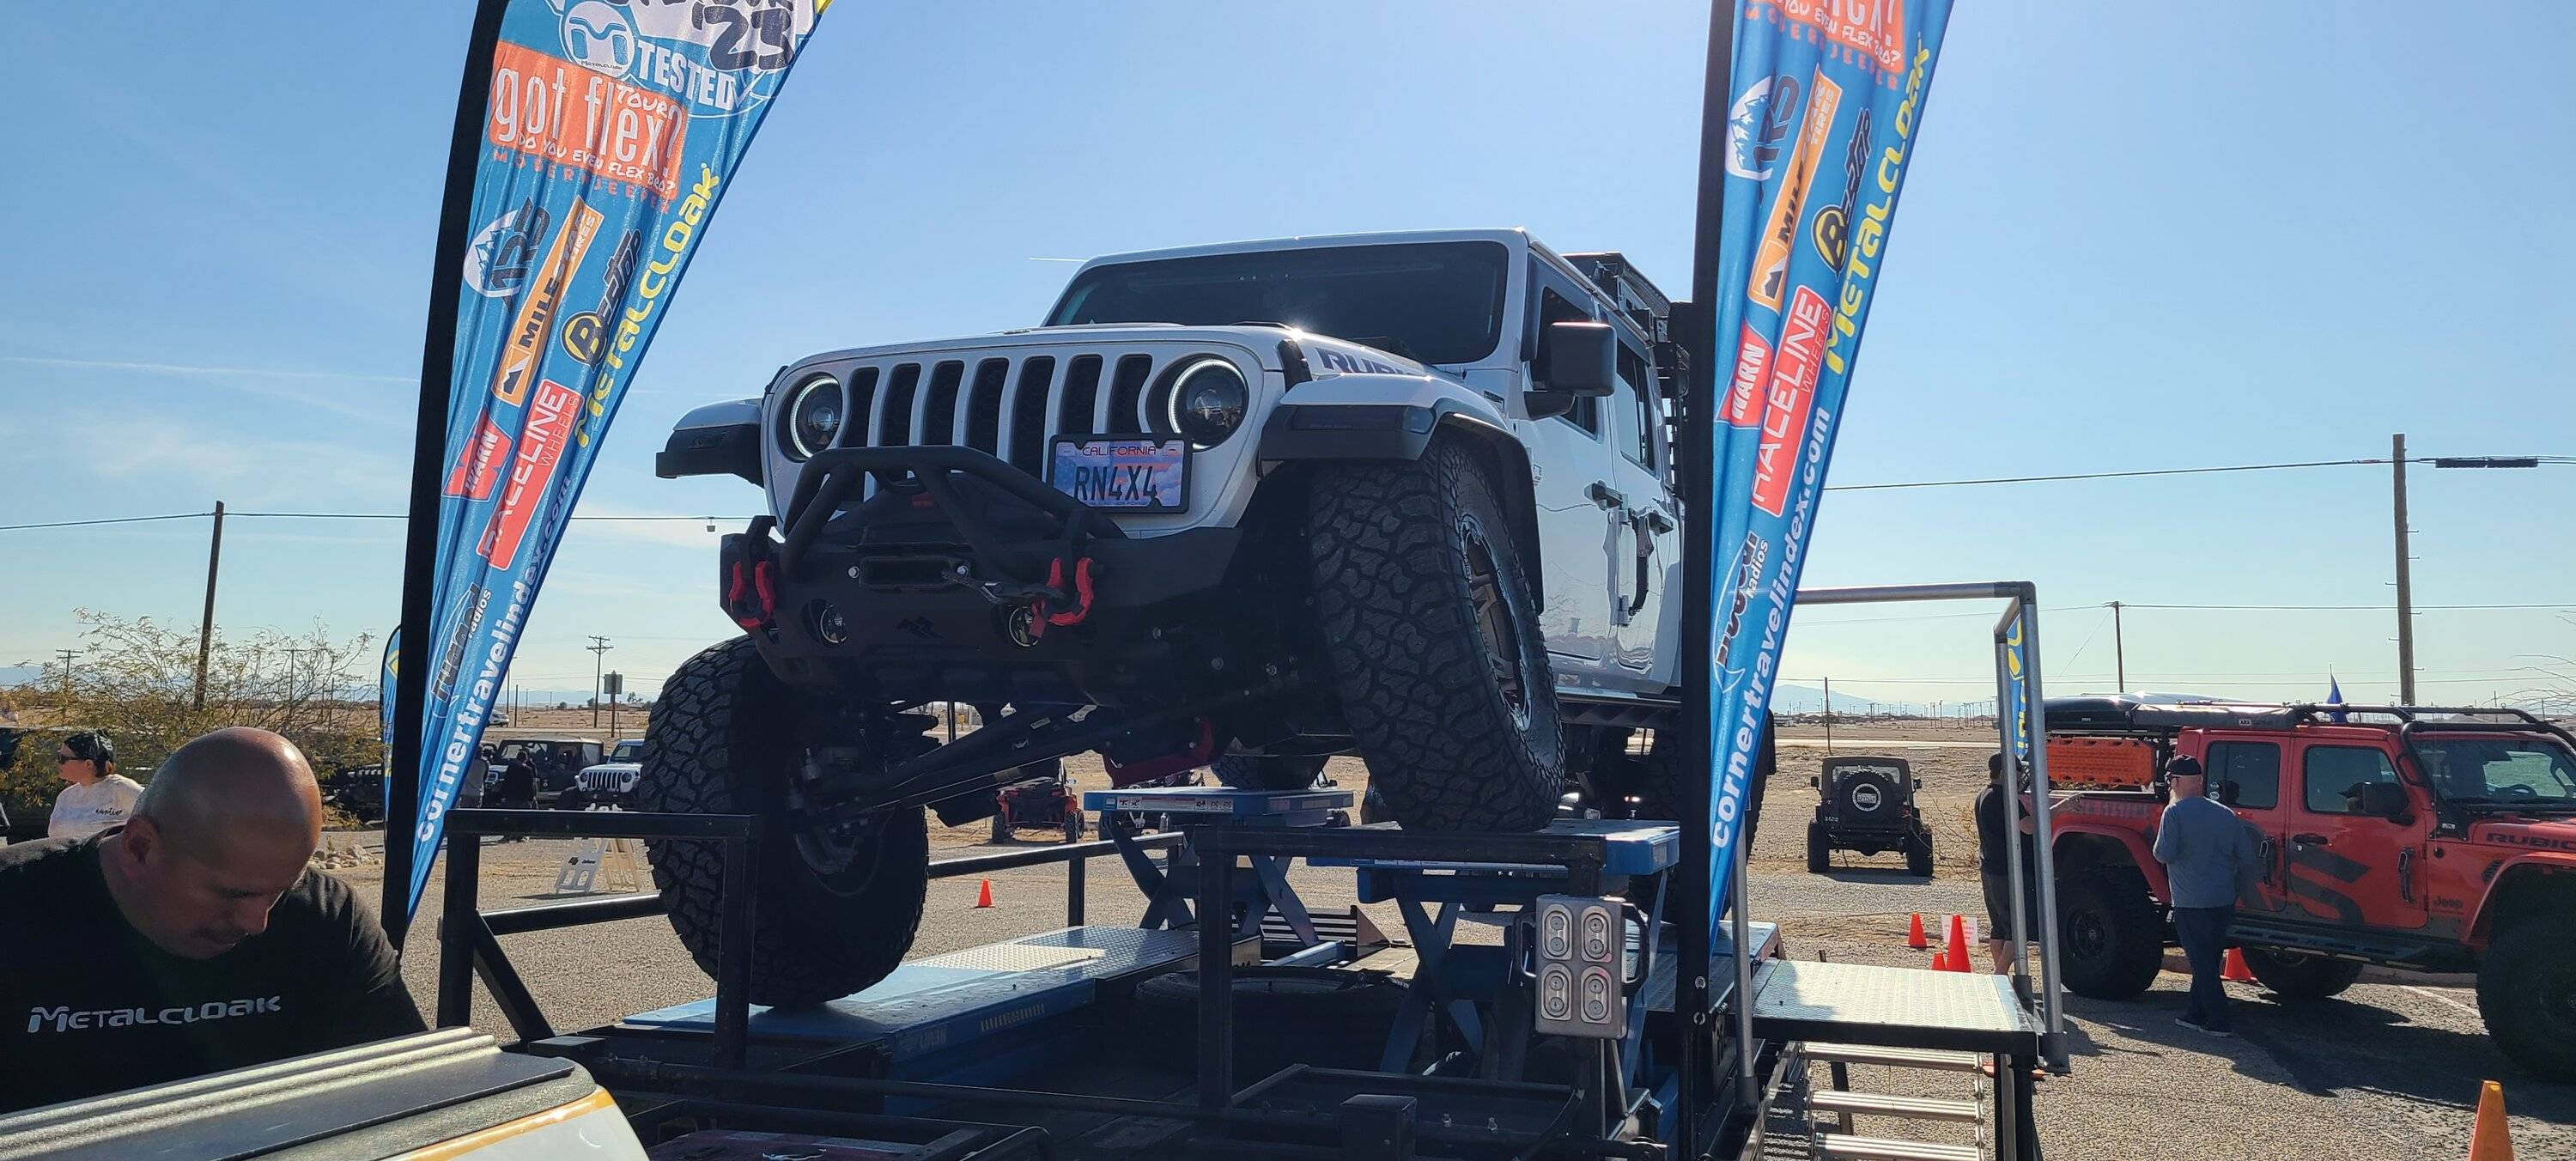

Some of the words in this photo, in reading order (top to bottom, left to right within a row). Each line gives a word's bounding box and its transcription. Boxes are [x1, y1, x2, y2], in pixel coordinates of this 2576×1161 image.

[637, 40, 738, 110] TESTED
[495, 67, 567, 143] got
[585, 76, 683, 177] flex?
[543, 140, 567, 158] YOU
[572, 149, 605, 170] EVEN
[608, 162, 644, 180] FLEX
[1731, 342, 1765, 420] WARN
[1800, 307, 1831, 394] WHEELS
[538, 395, 580, 467] WHEELS
[1082, 446, 1157, 457] CALIFORNIA
[1074, 465, 1157, 501] RN4X4
[417, 475, 572, 842] cornertravelindex.com
[1711, 406, 1831, 848] cornertravelindex.com
